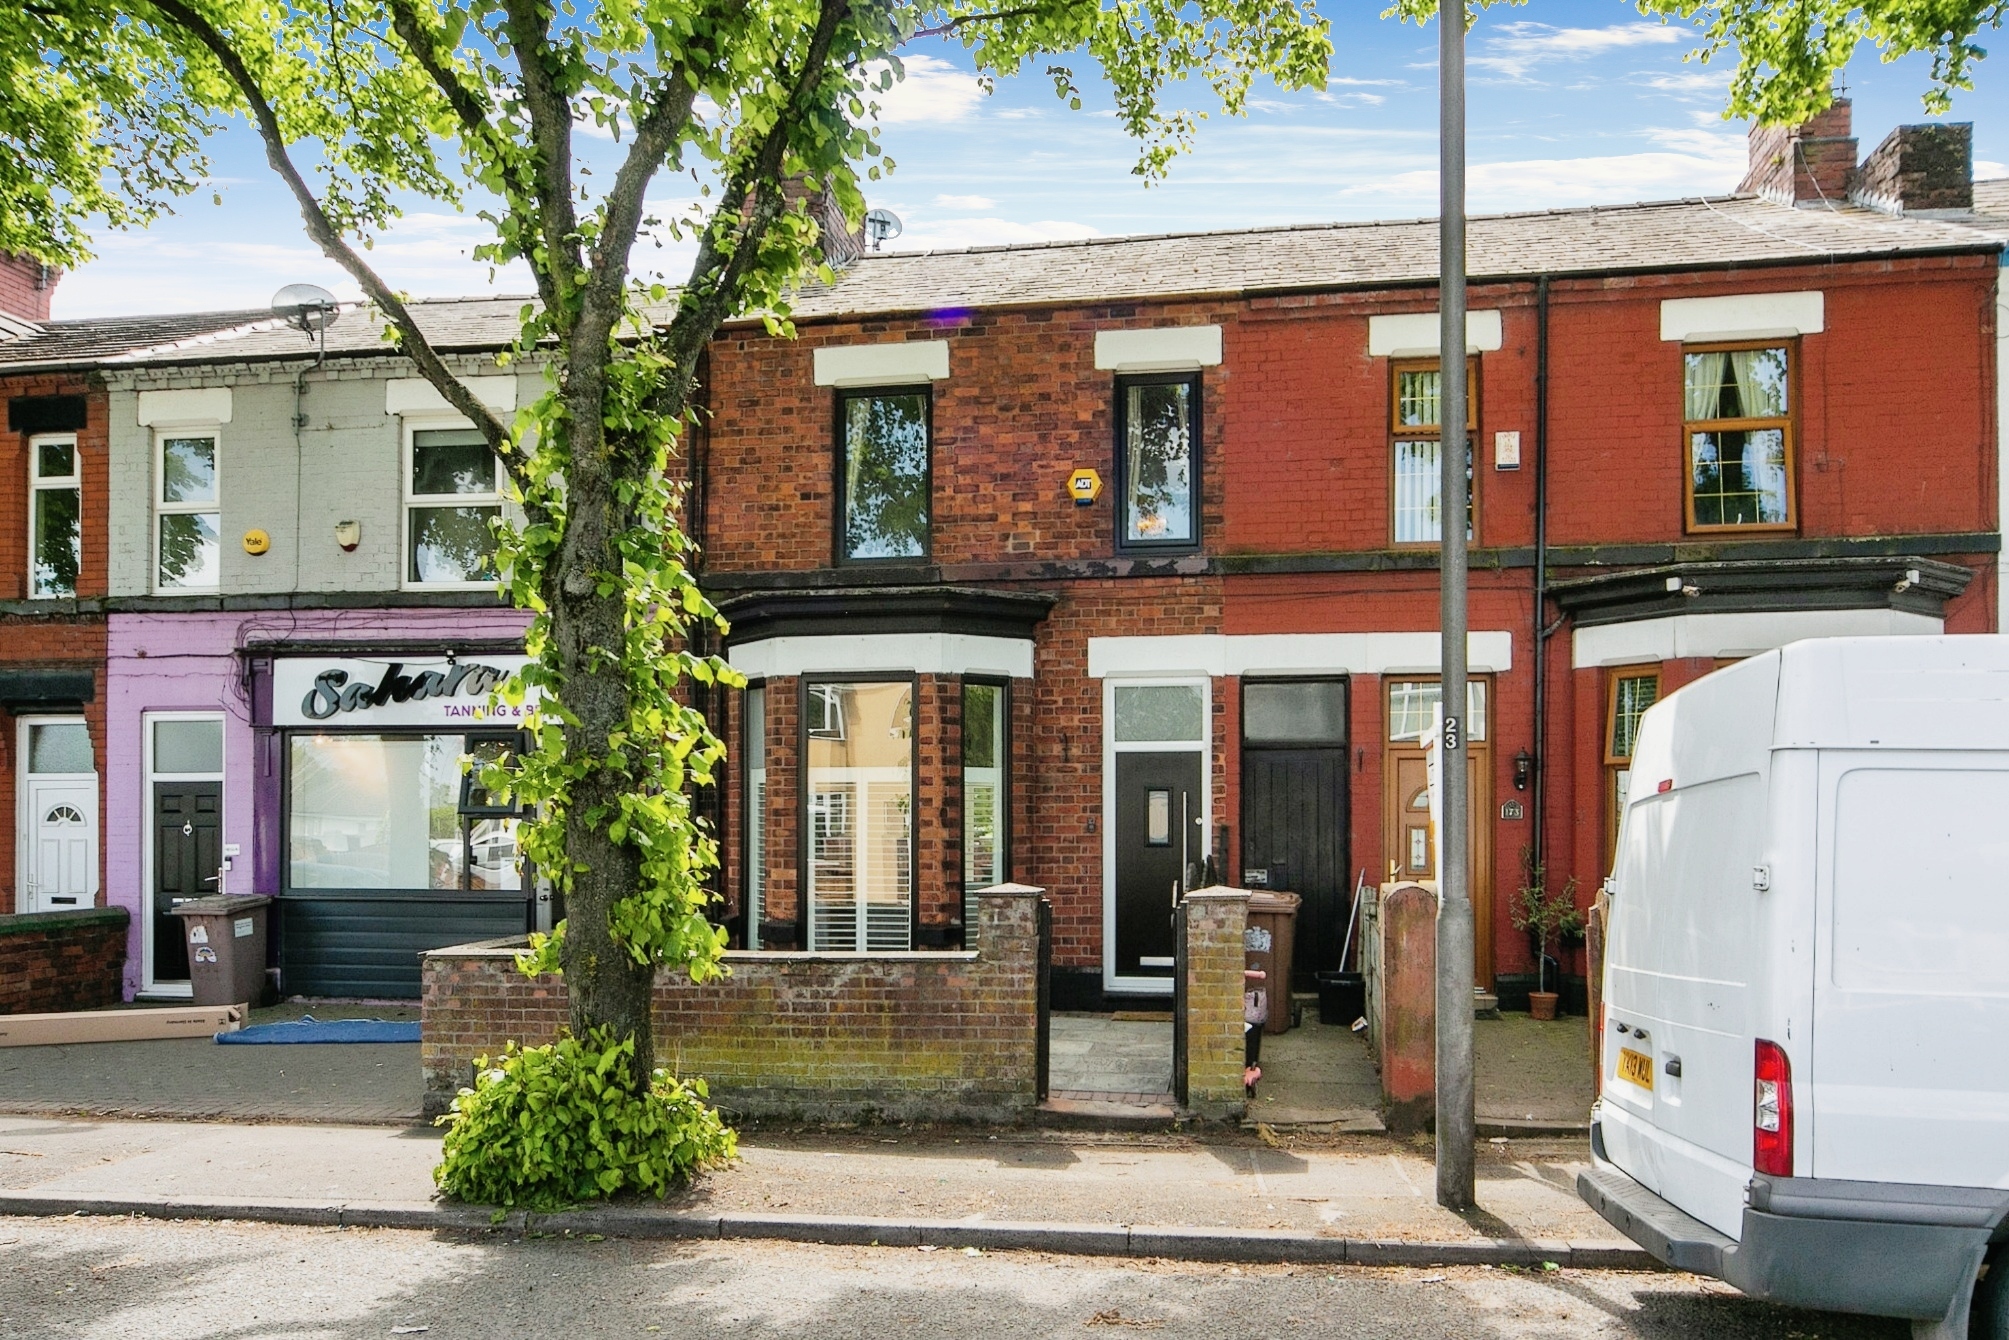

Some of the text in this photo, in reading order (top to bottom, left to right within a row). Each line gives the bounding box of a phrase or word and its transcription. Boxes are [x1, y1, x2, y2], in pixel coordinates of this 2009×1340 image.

[1075, 478, 1091, 489] ADT
[245, 538, 262, 546] Yale
[302, 663, 509, 720] Sahara
[511, 705, 521, 717] &
